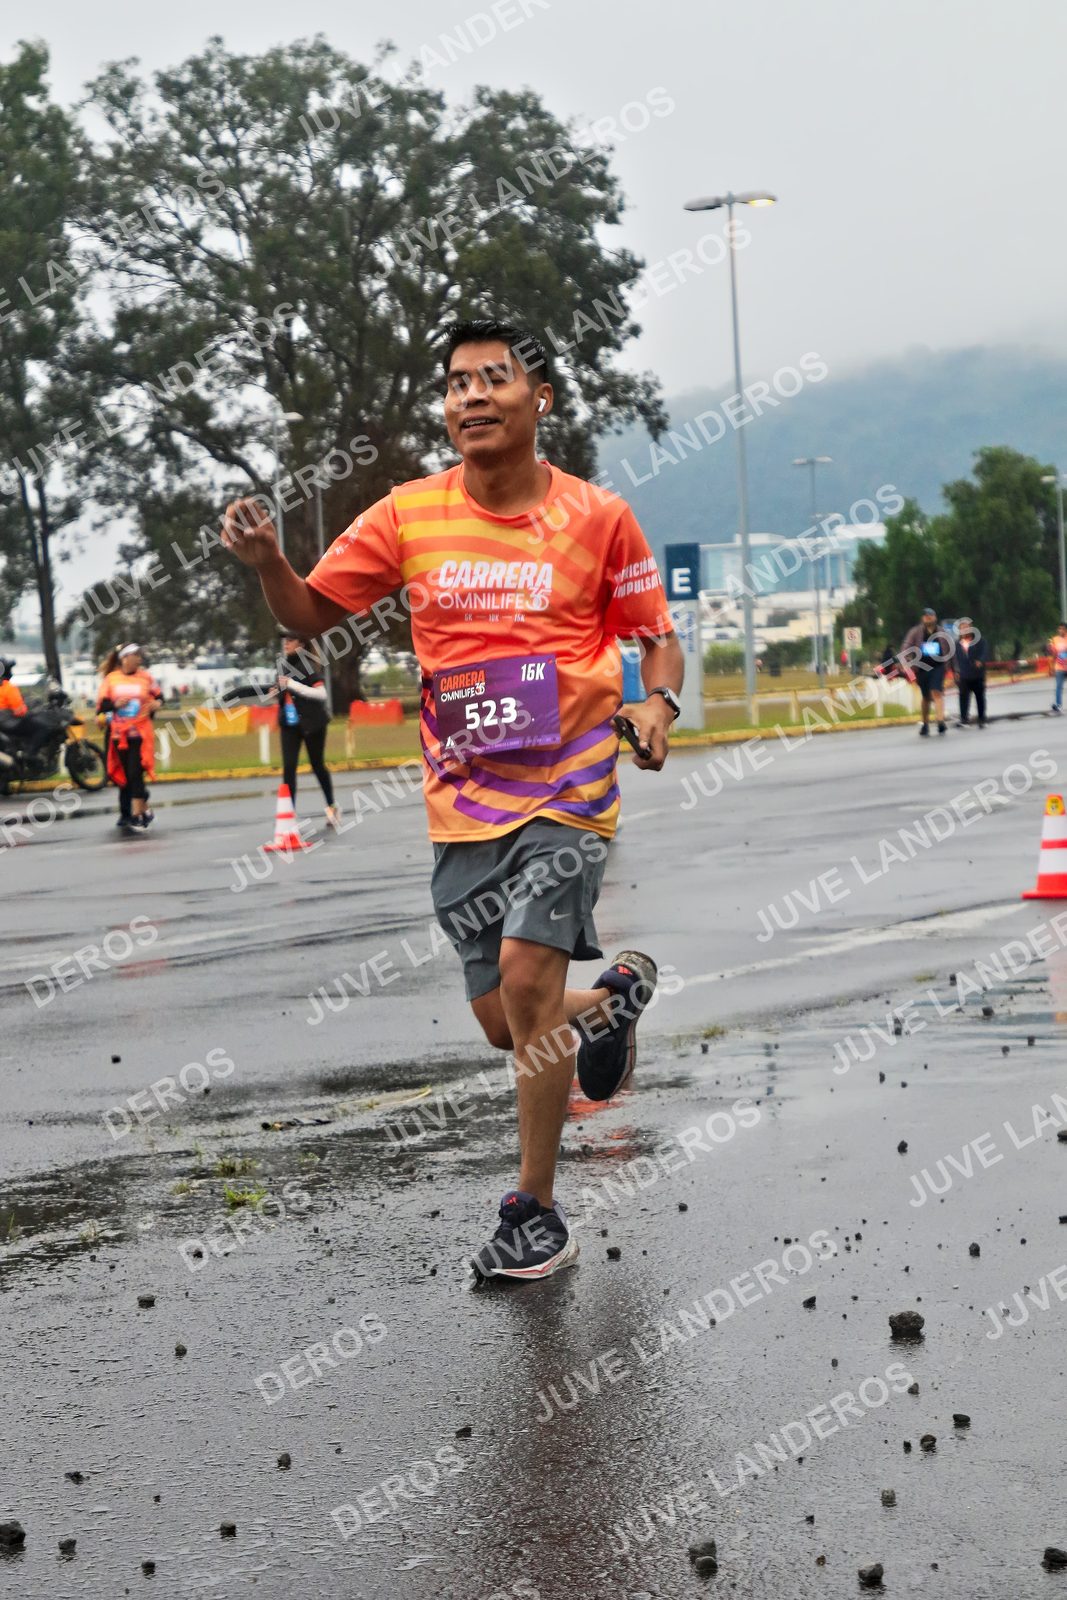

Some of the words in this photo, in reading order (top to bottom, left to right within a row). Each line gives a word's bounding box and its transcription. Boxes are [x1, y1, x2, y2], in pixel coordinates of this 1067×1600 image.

[437, 560, 553, 589] CARRERA
[671, 567, 692, 594] E
[437, 591, 524, 610] OMNILIFE
[440, 669, 486, 693] CARRERA
[465, 697, 518, 730] 523
